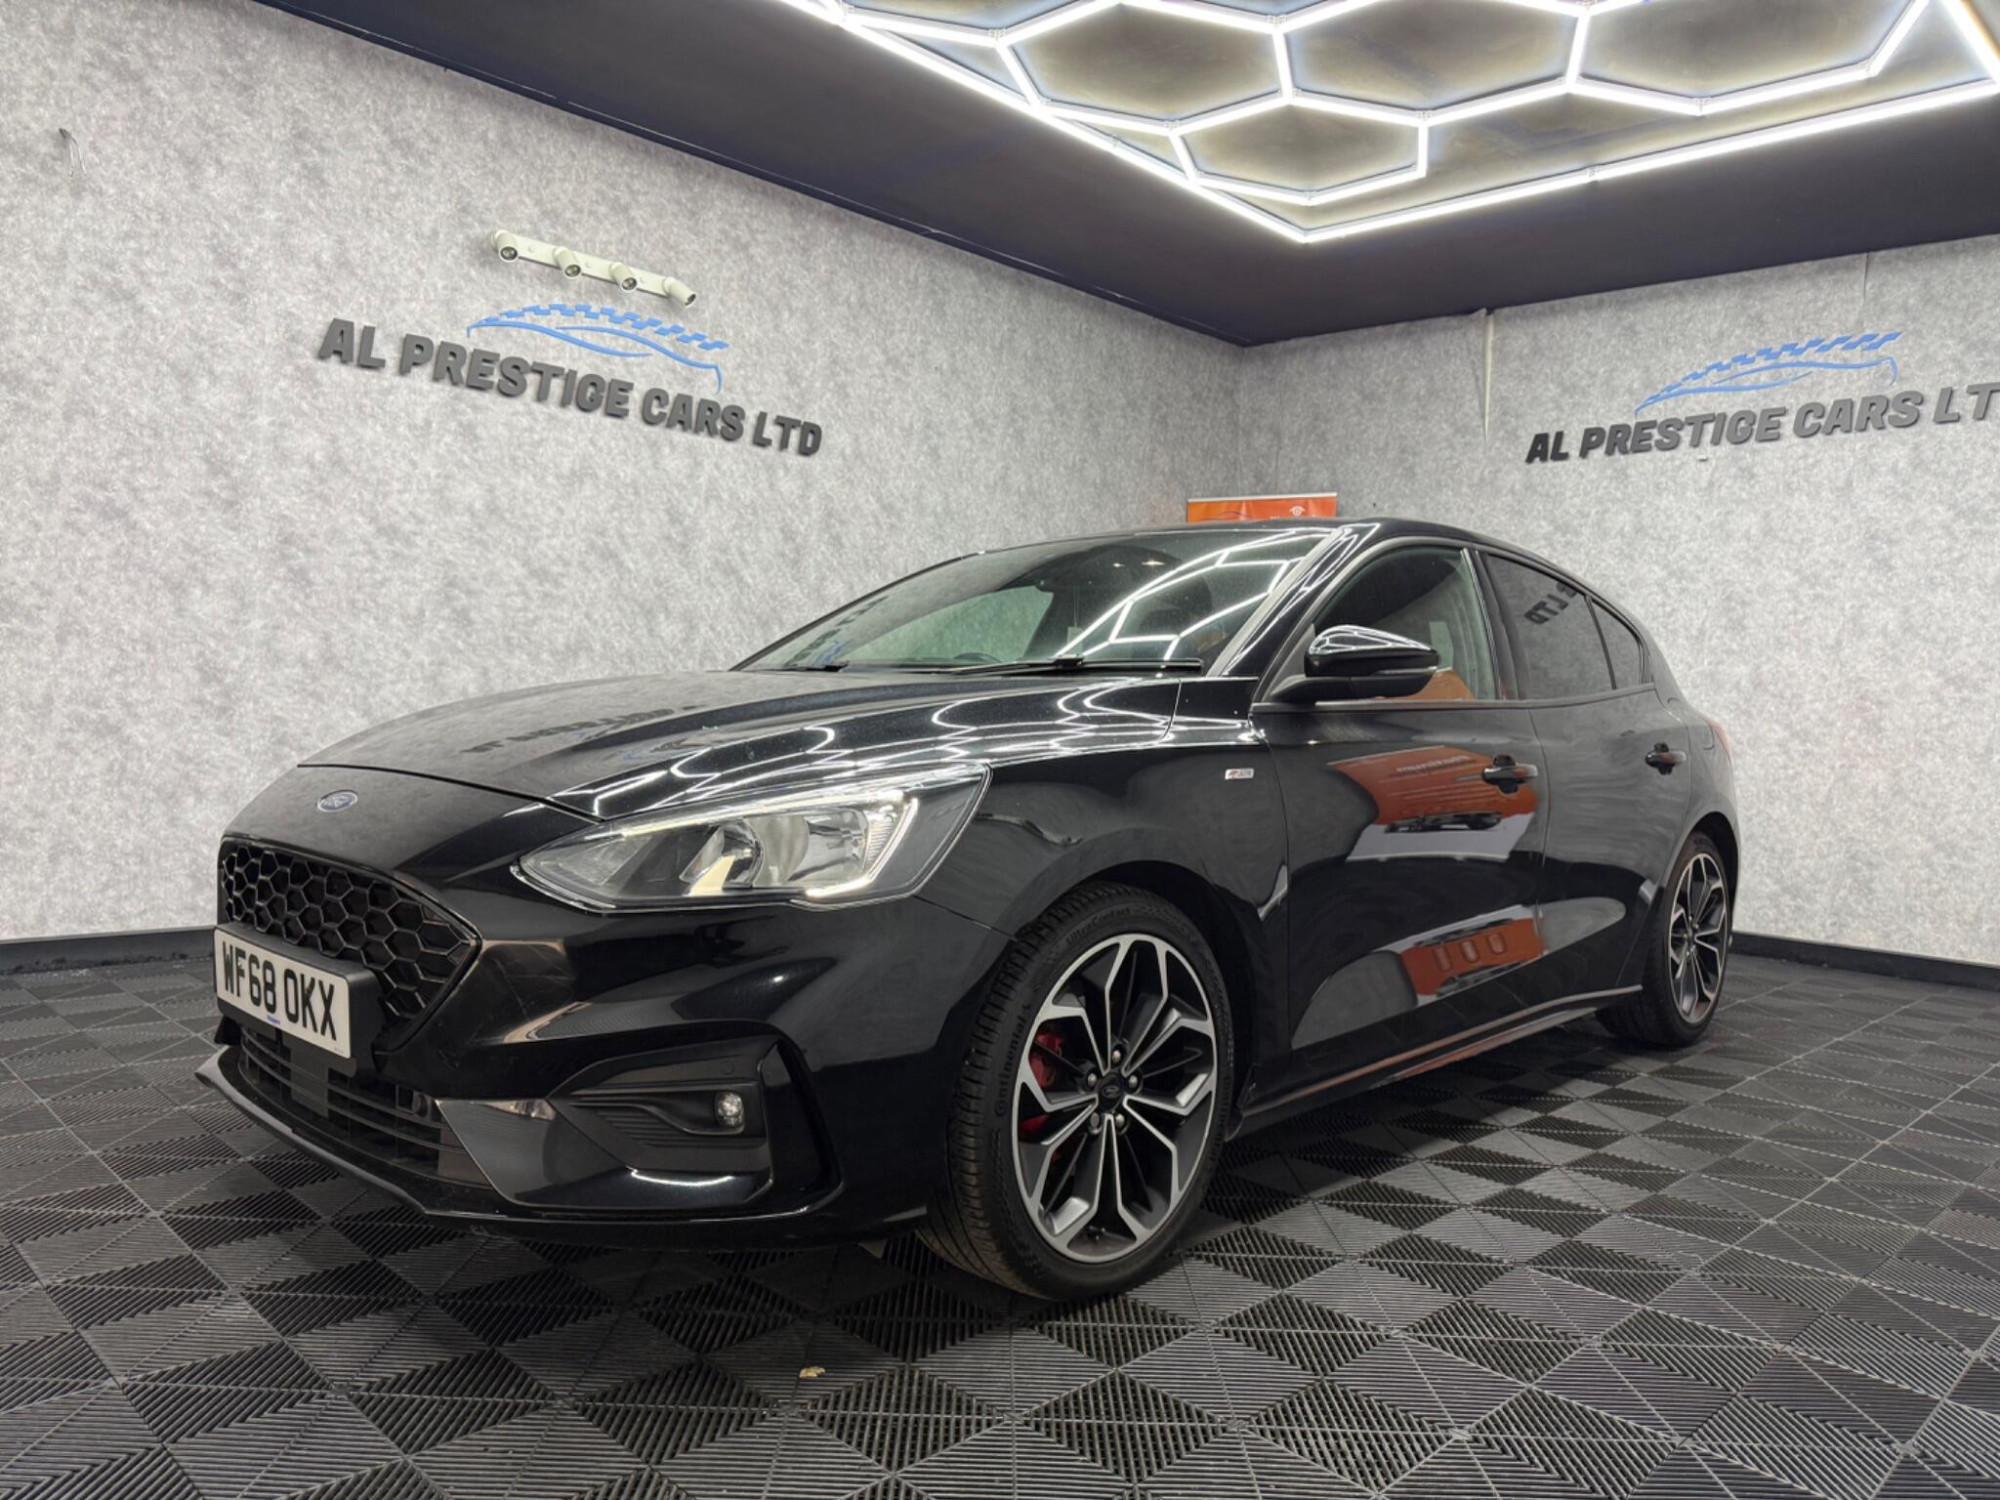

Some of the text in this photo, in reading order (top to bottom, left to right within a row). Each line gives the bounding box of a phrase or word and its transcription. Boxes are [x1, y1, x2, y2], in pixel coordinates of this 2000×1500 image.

[317, 318, 823, 456] AL PRESTIGE CARS LTD
[1525, 431, 1570, 464] AL
[1578, 406, 1788, 459] PRESTIGE
[1793, 390, 1925, 440] CARS
[222, 941, 337, 1041] WF68 OKX
